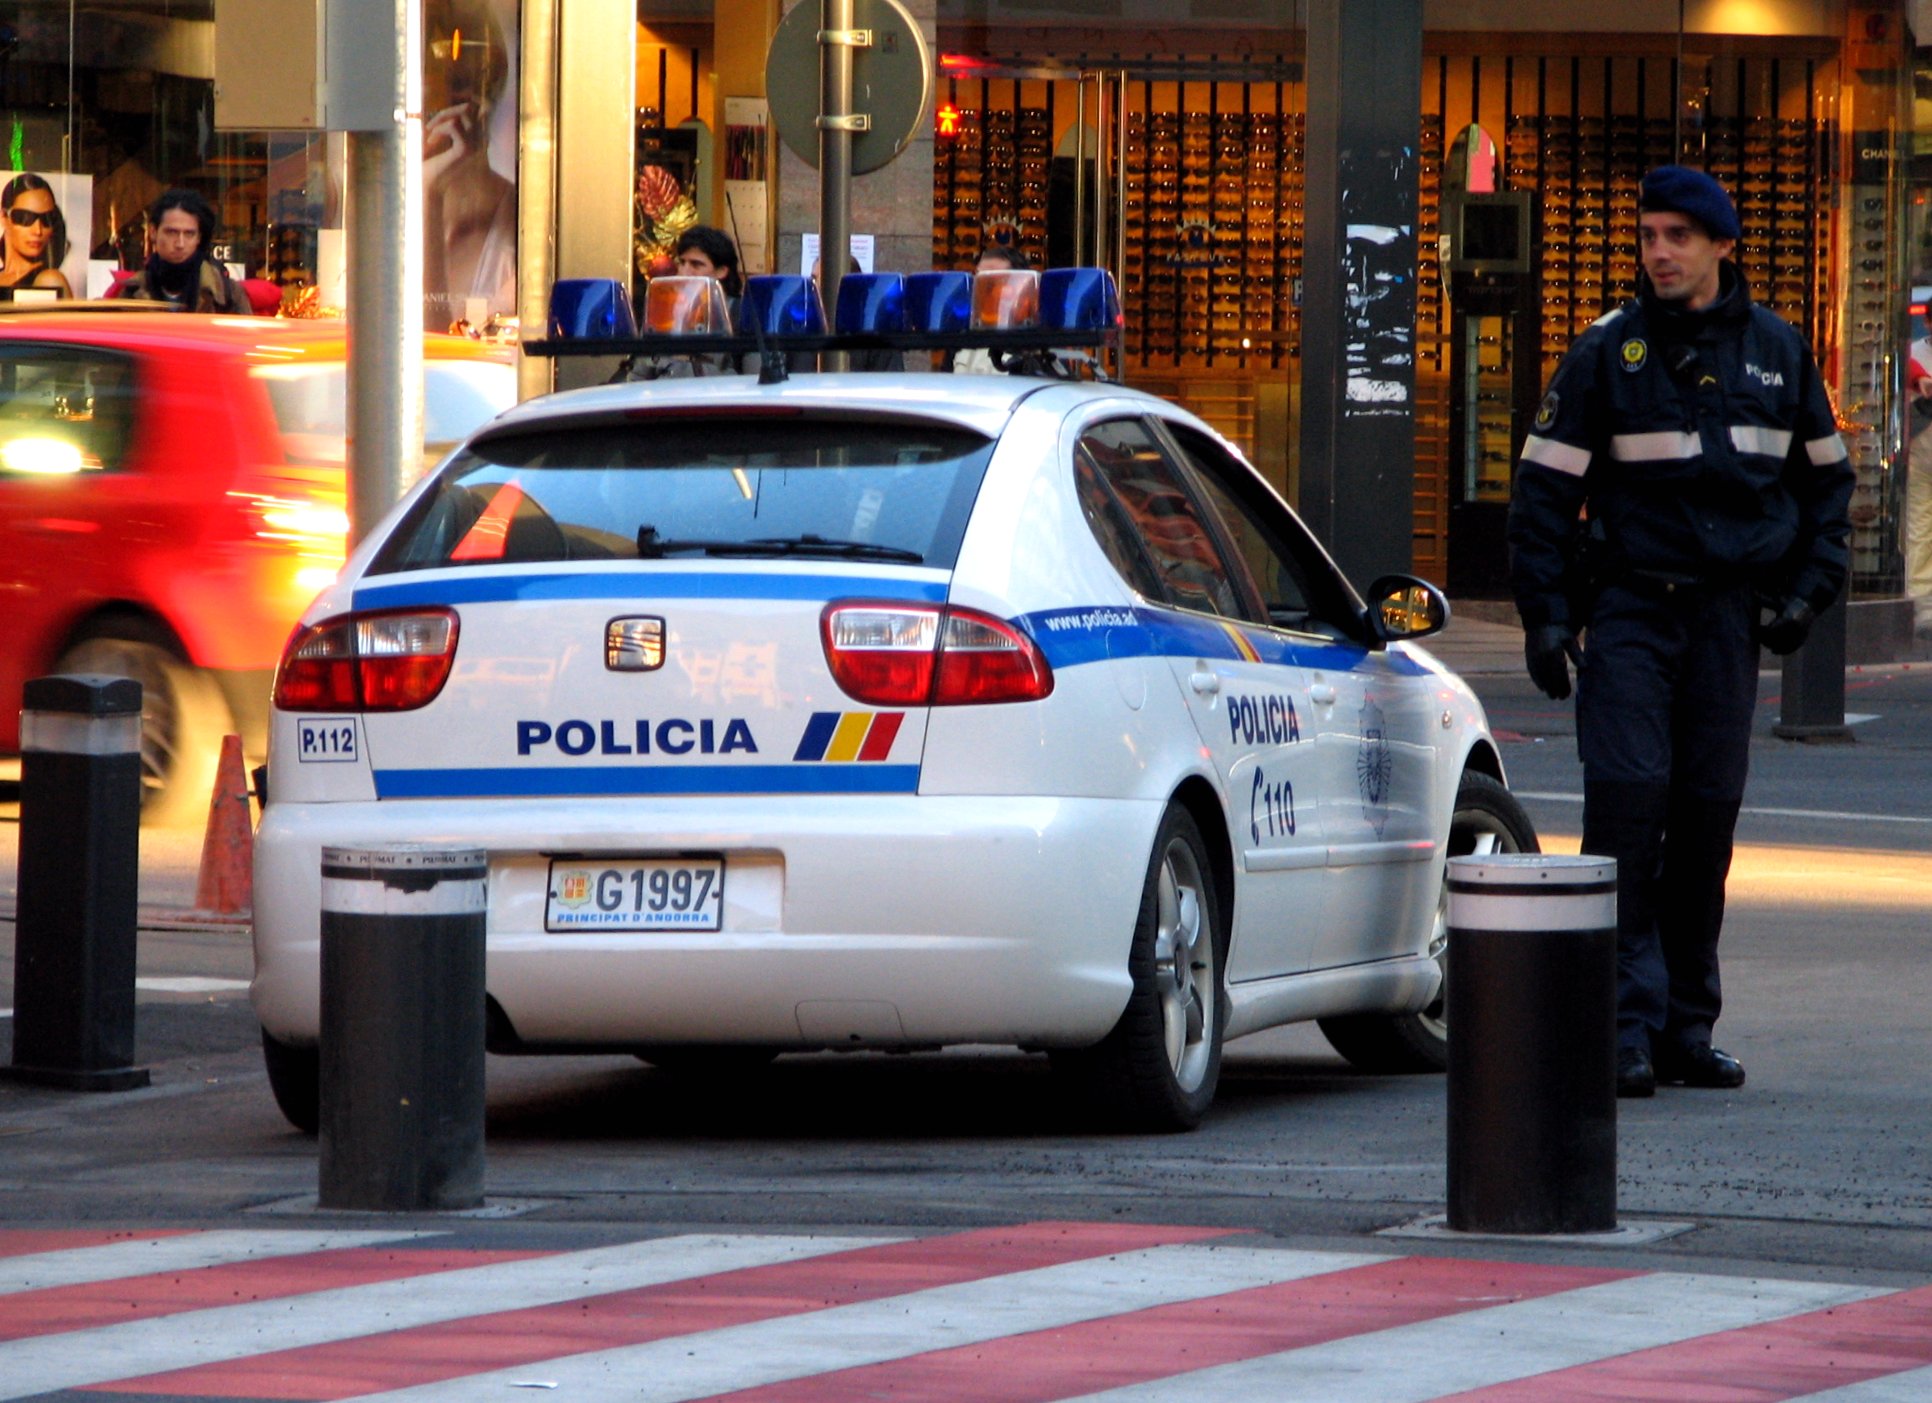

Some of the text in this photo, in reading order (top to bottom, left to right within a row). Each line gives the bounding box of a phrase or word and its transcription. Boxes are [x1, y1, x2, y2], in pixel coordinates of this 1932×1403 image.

[1745, 363, 1784, 386] POCIA
[1045, 609, 1138, 632] www.policia.ad
[1226, 694, 1300, 745] POLICIA
[302, 728, 353, 753] P.112
[516, 719, 759, 756] POLICIA
[1264, 780, 1296, 837] 110
[596, 869, 716, 912] G1997
[557, 912, 710, 924] PRINCIPAT D'ANDORRA
